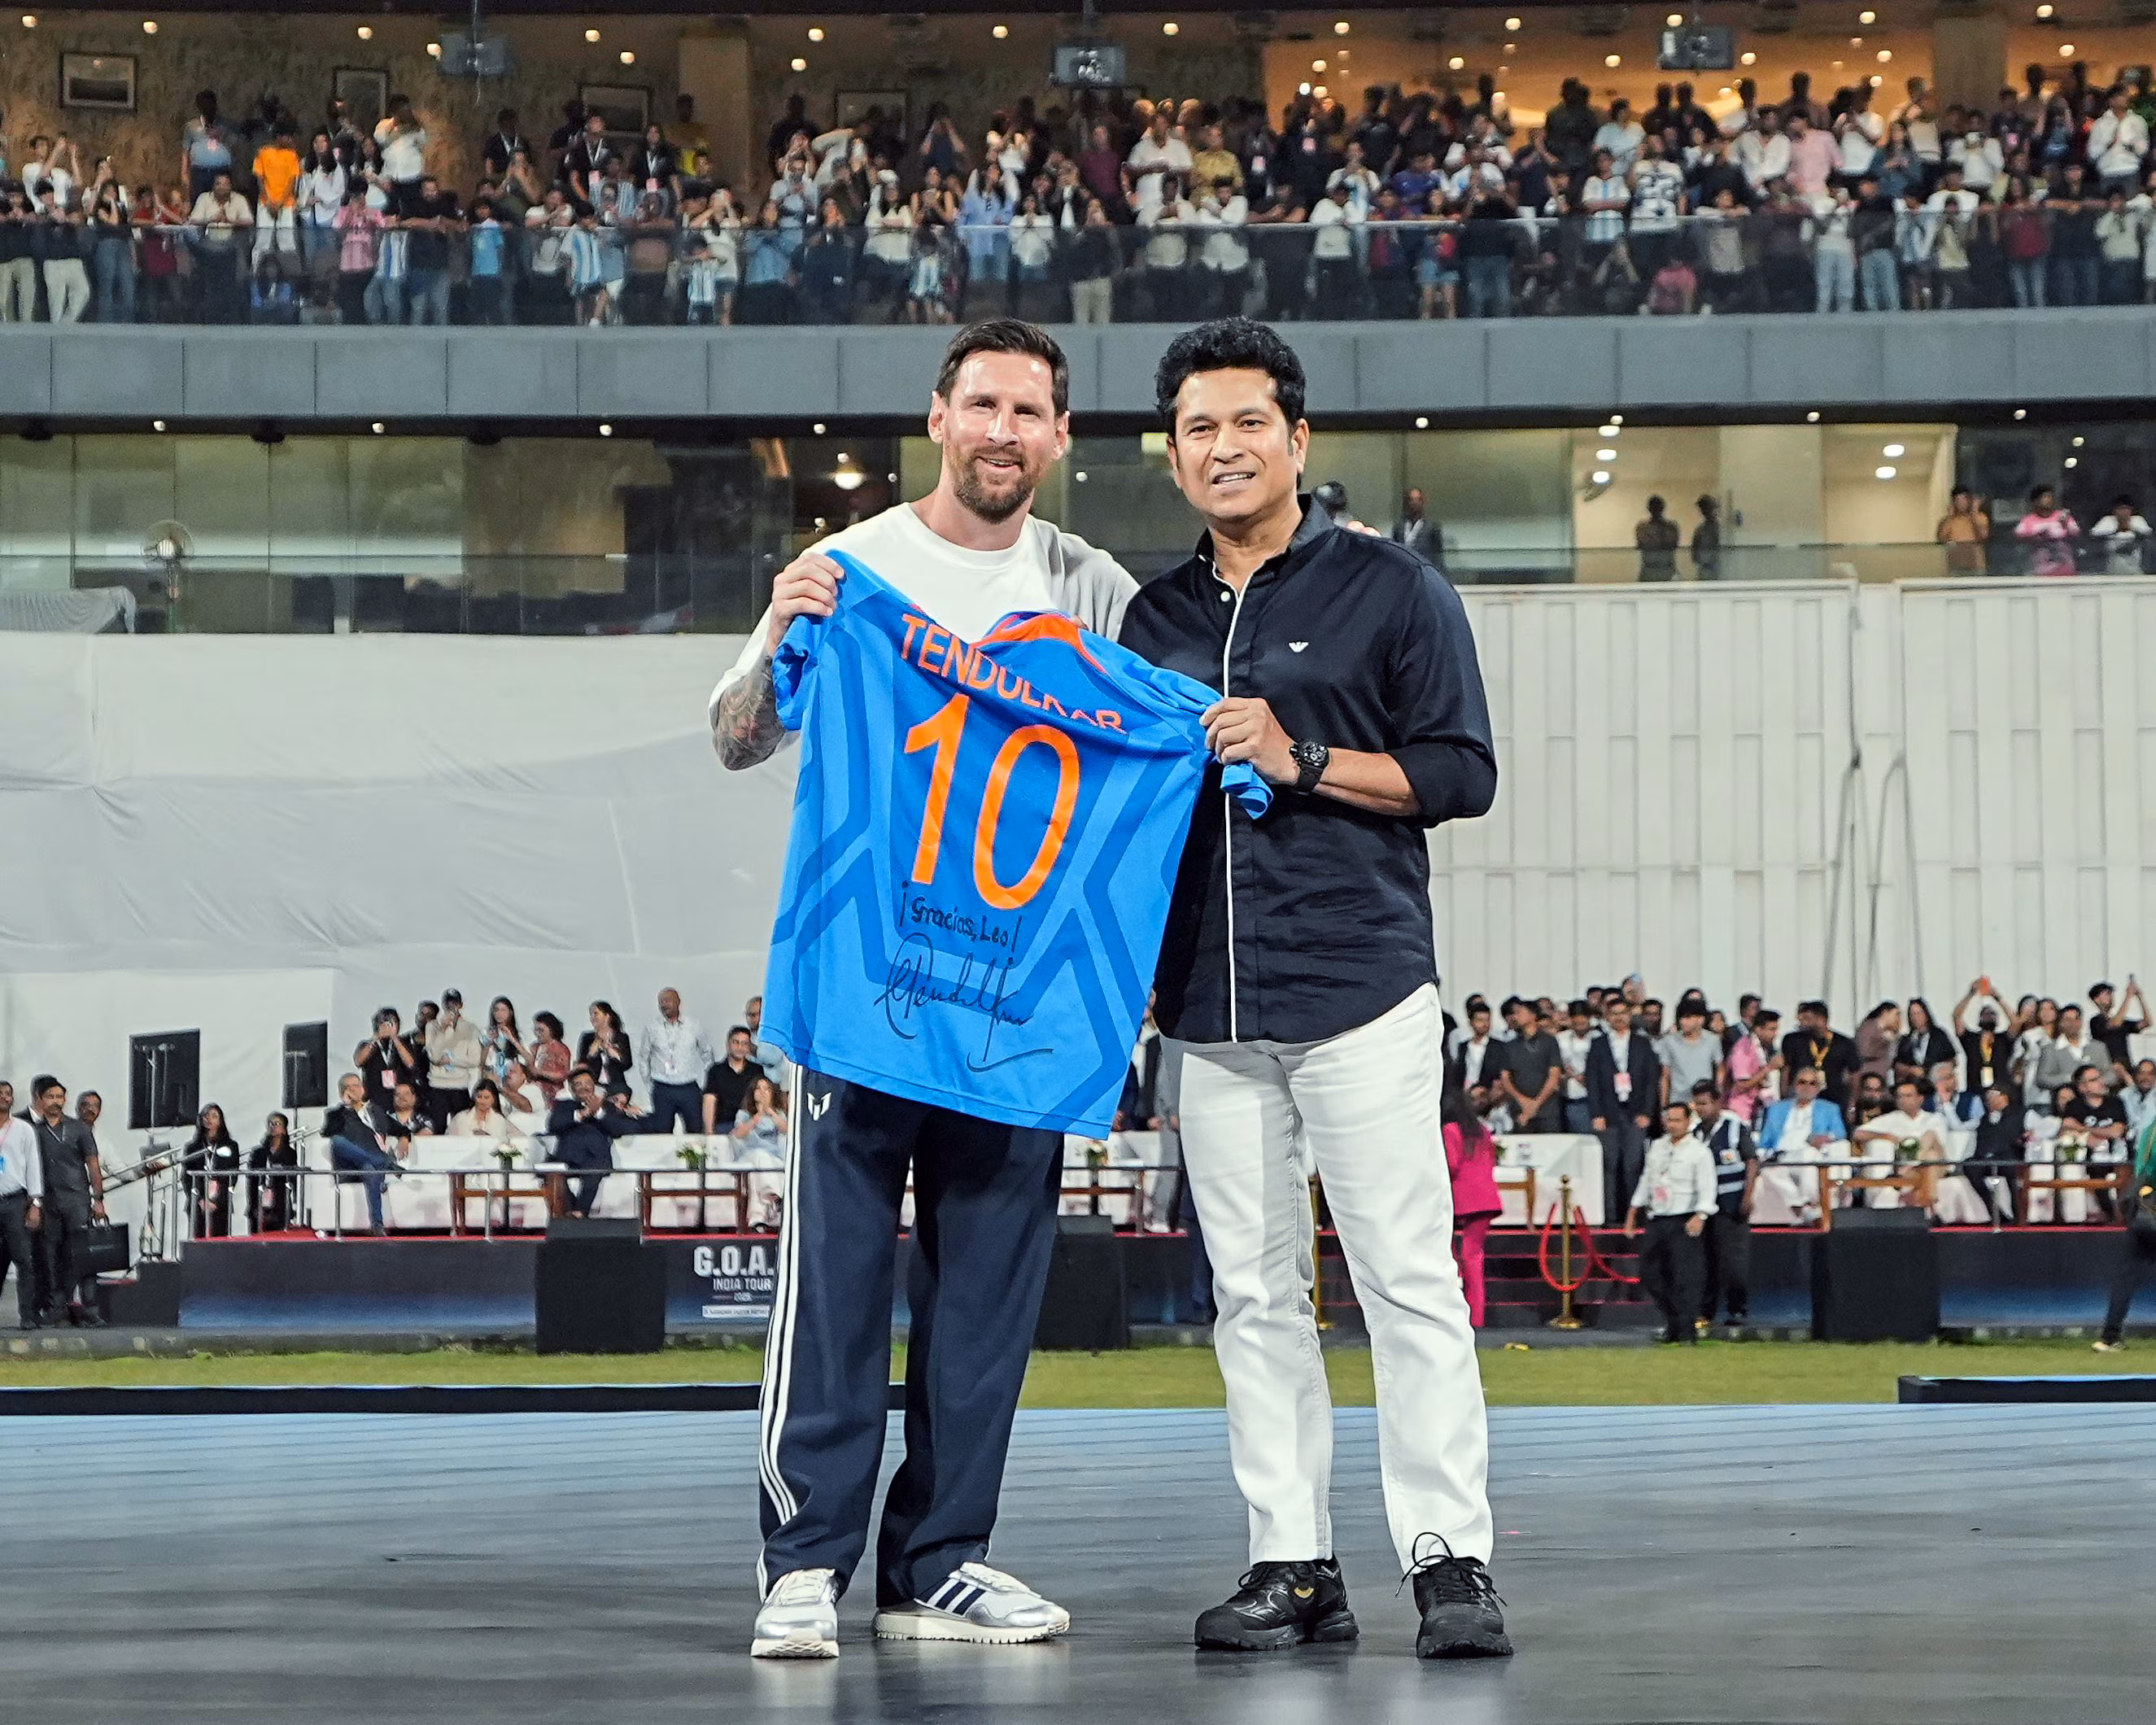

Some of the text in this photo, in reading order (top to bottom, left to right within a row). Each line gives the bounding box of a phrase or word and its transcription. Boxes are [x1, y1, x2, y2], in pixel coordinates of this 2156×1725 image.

[904, 692, 1081, 911] 10
[693, 1245, 777, 1277] G.O.A.
[713, 1277, 772, 1292] INDIA TOUR
